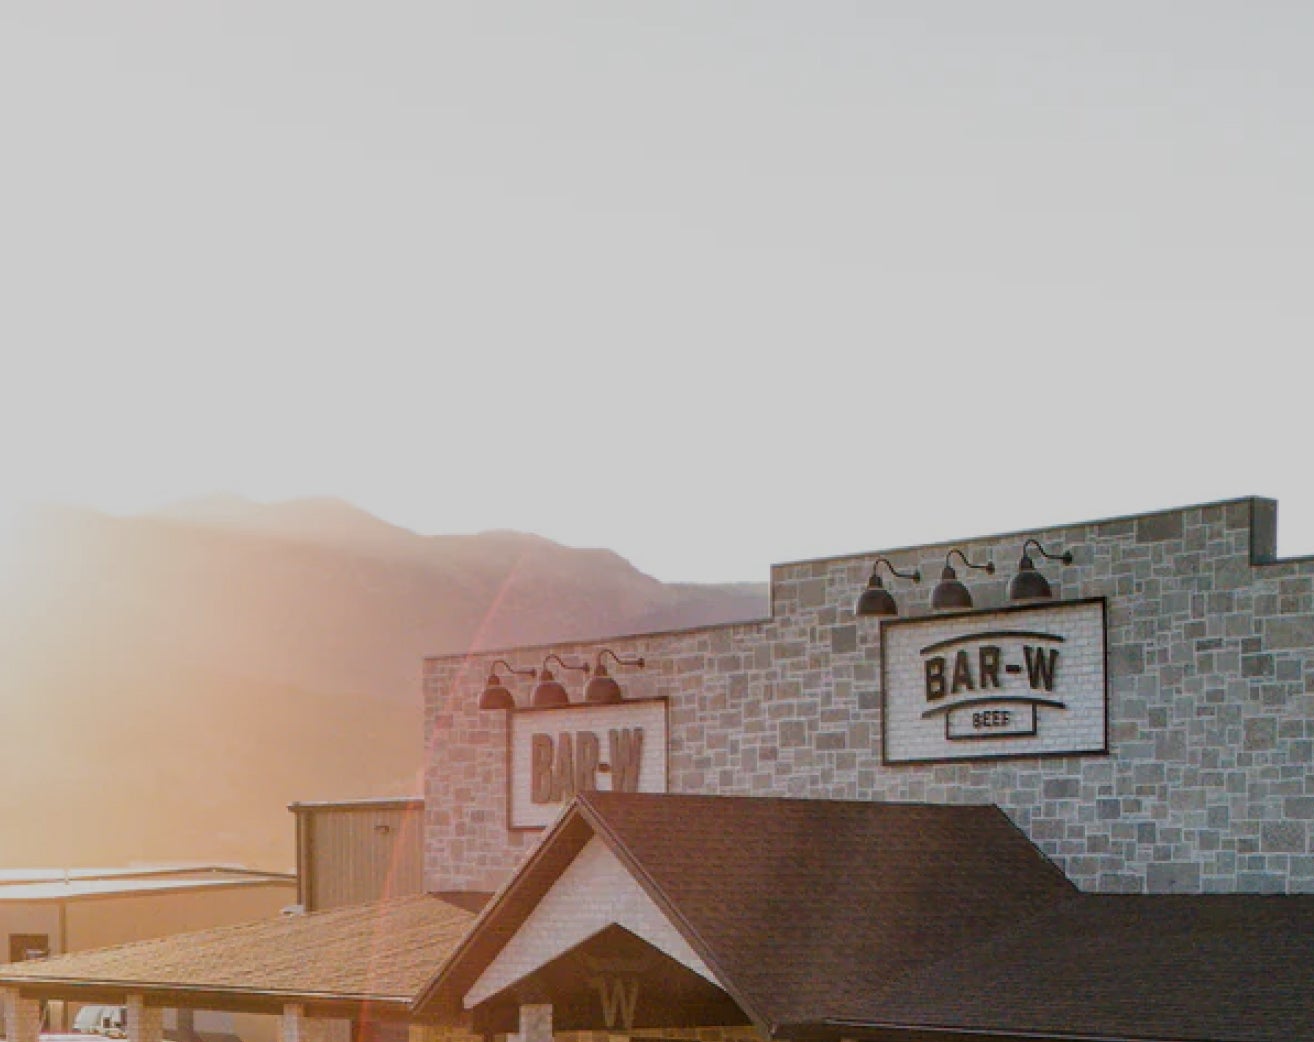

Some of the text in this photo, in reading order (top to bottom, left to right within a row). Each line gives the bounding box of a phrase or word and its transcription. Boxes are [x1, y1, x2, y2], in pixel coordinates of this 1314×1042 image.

[925, 645, 1060, 702] BAR-W
[972, 710, 1010, 729] BEEF
[531, 728, 643, 803] BAR-W
